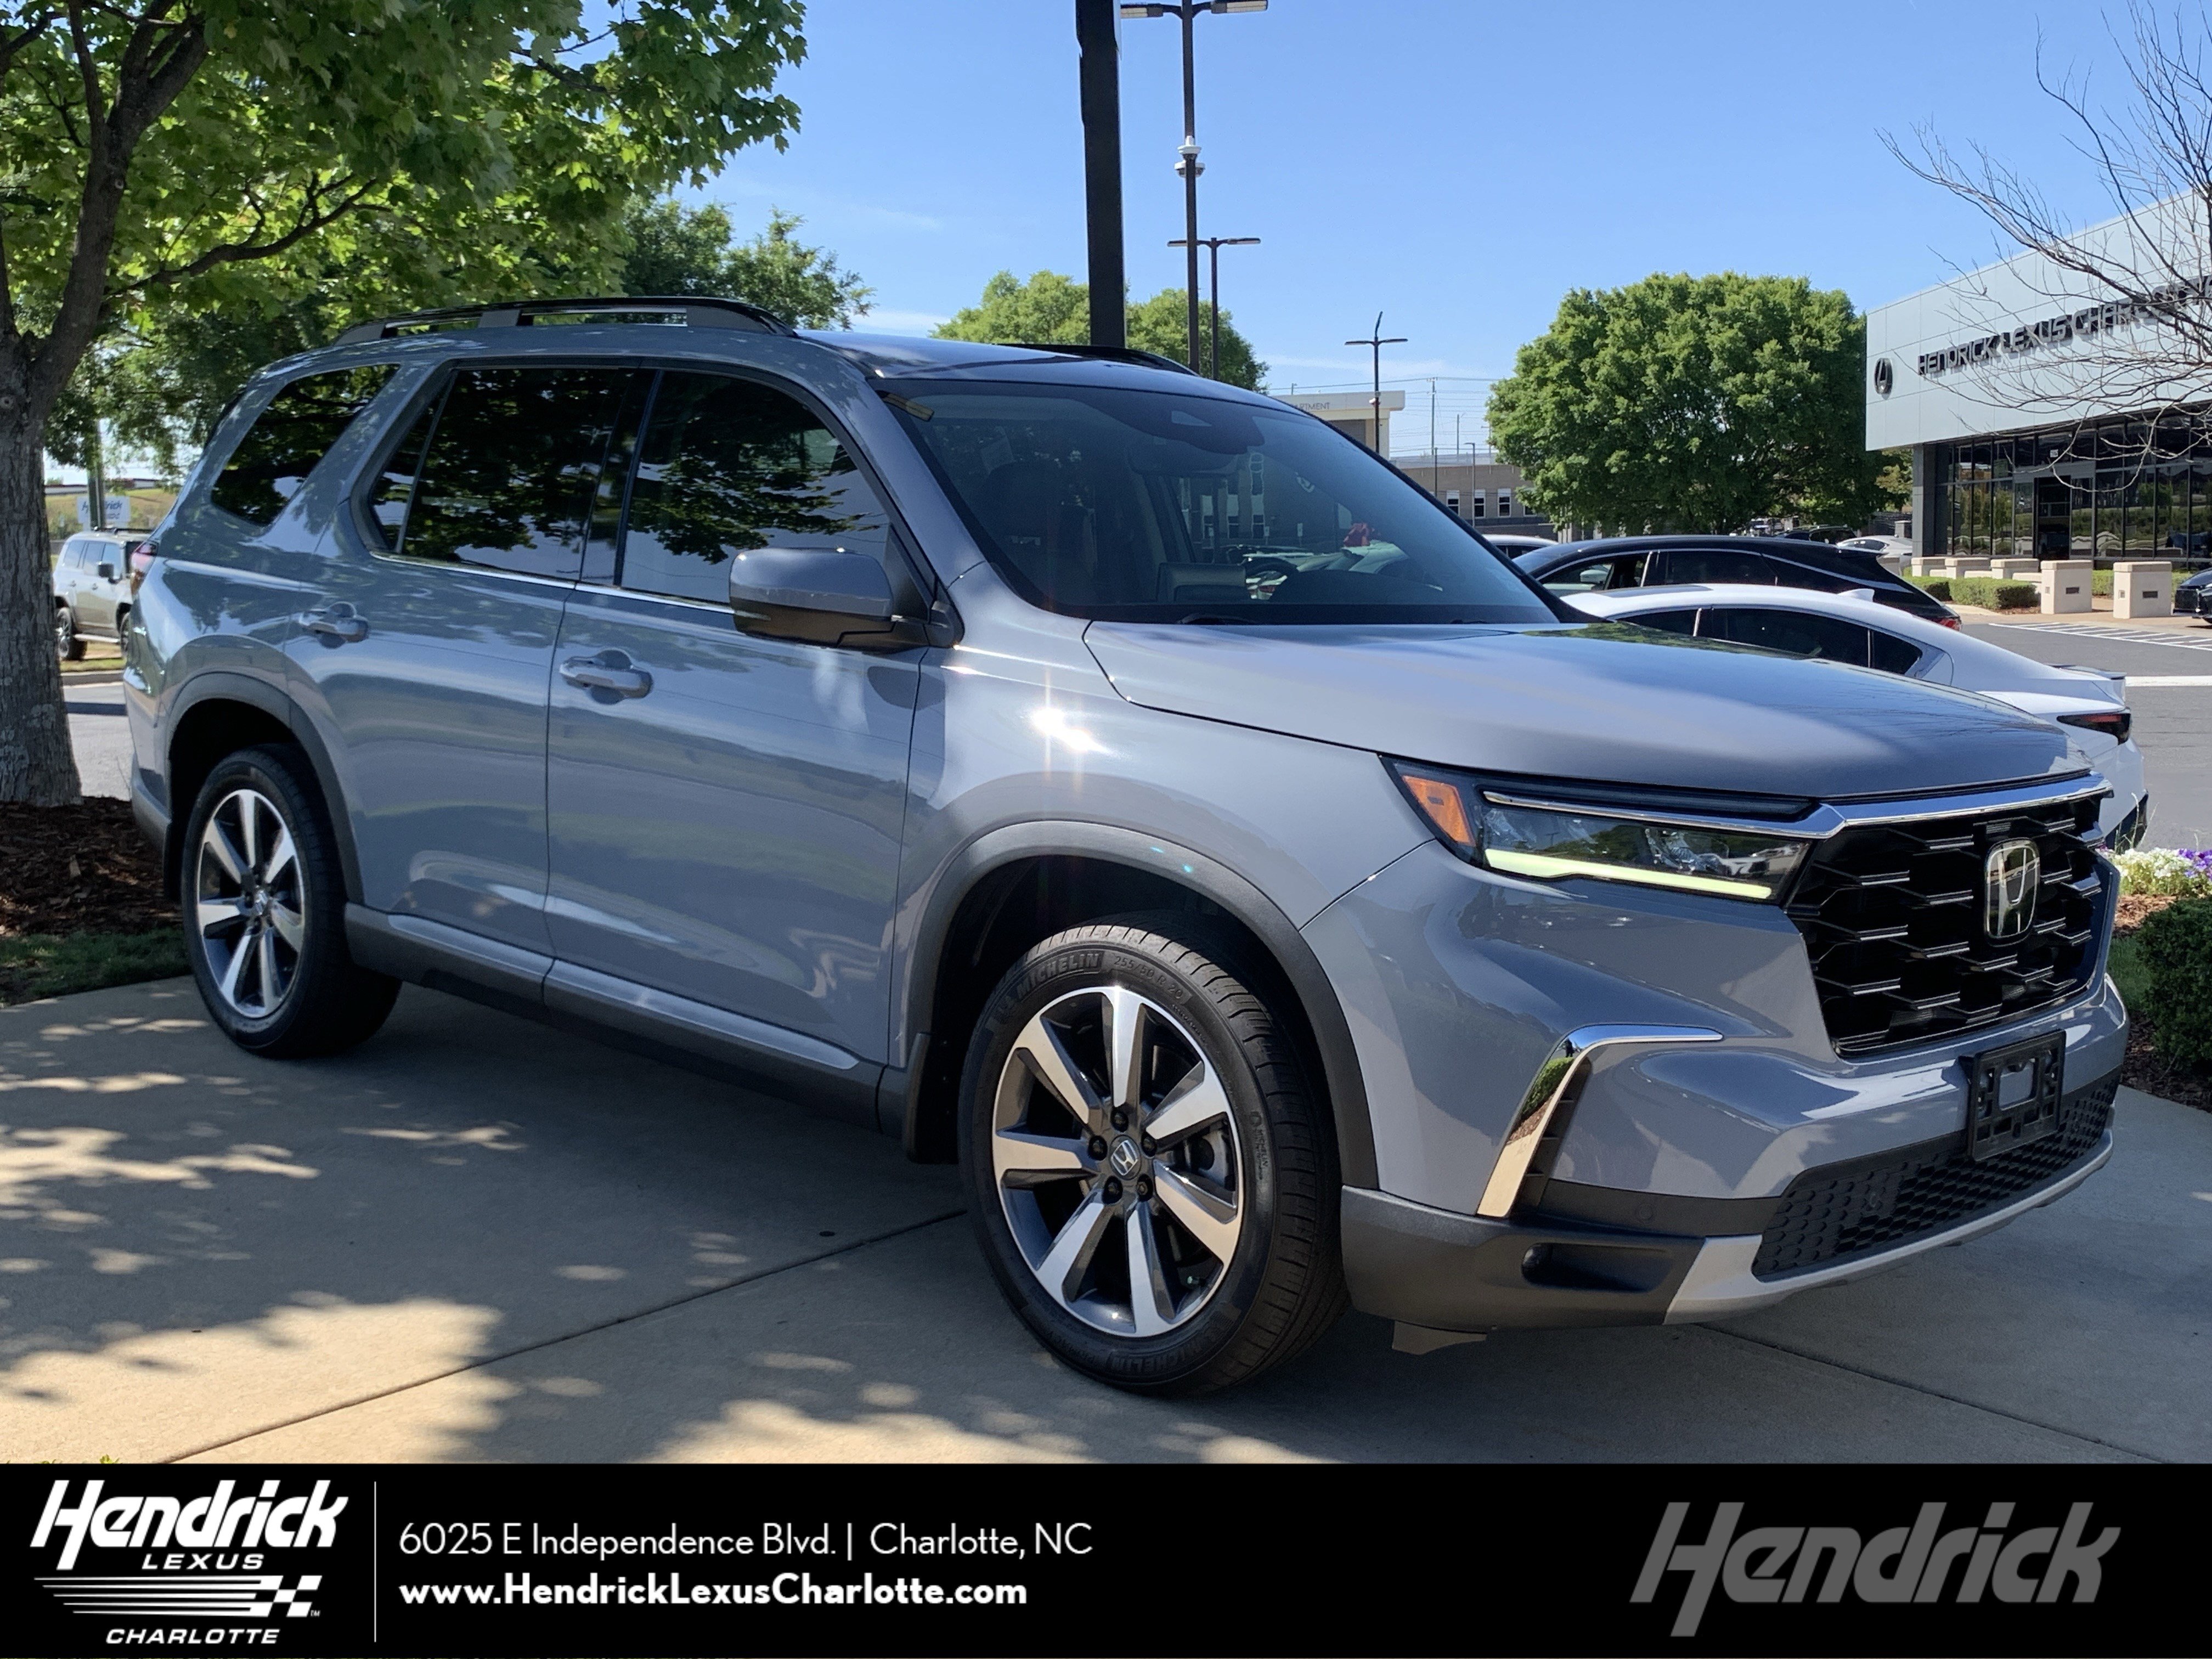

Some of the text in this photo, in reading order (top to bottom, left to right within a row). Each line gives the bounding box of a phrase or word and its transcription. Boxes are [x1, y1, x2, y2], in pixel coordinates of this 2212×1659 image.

[1917, 335, 2001, 376] HENDRICK
[1999, 314, 2075, 353] LEXUS
[1016, 953, 1100, 1001] MICHELIN
[1114, 956, 1183, 1000] 255/50 R 20
